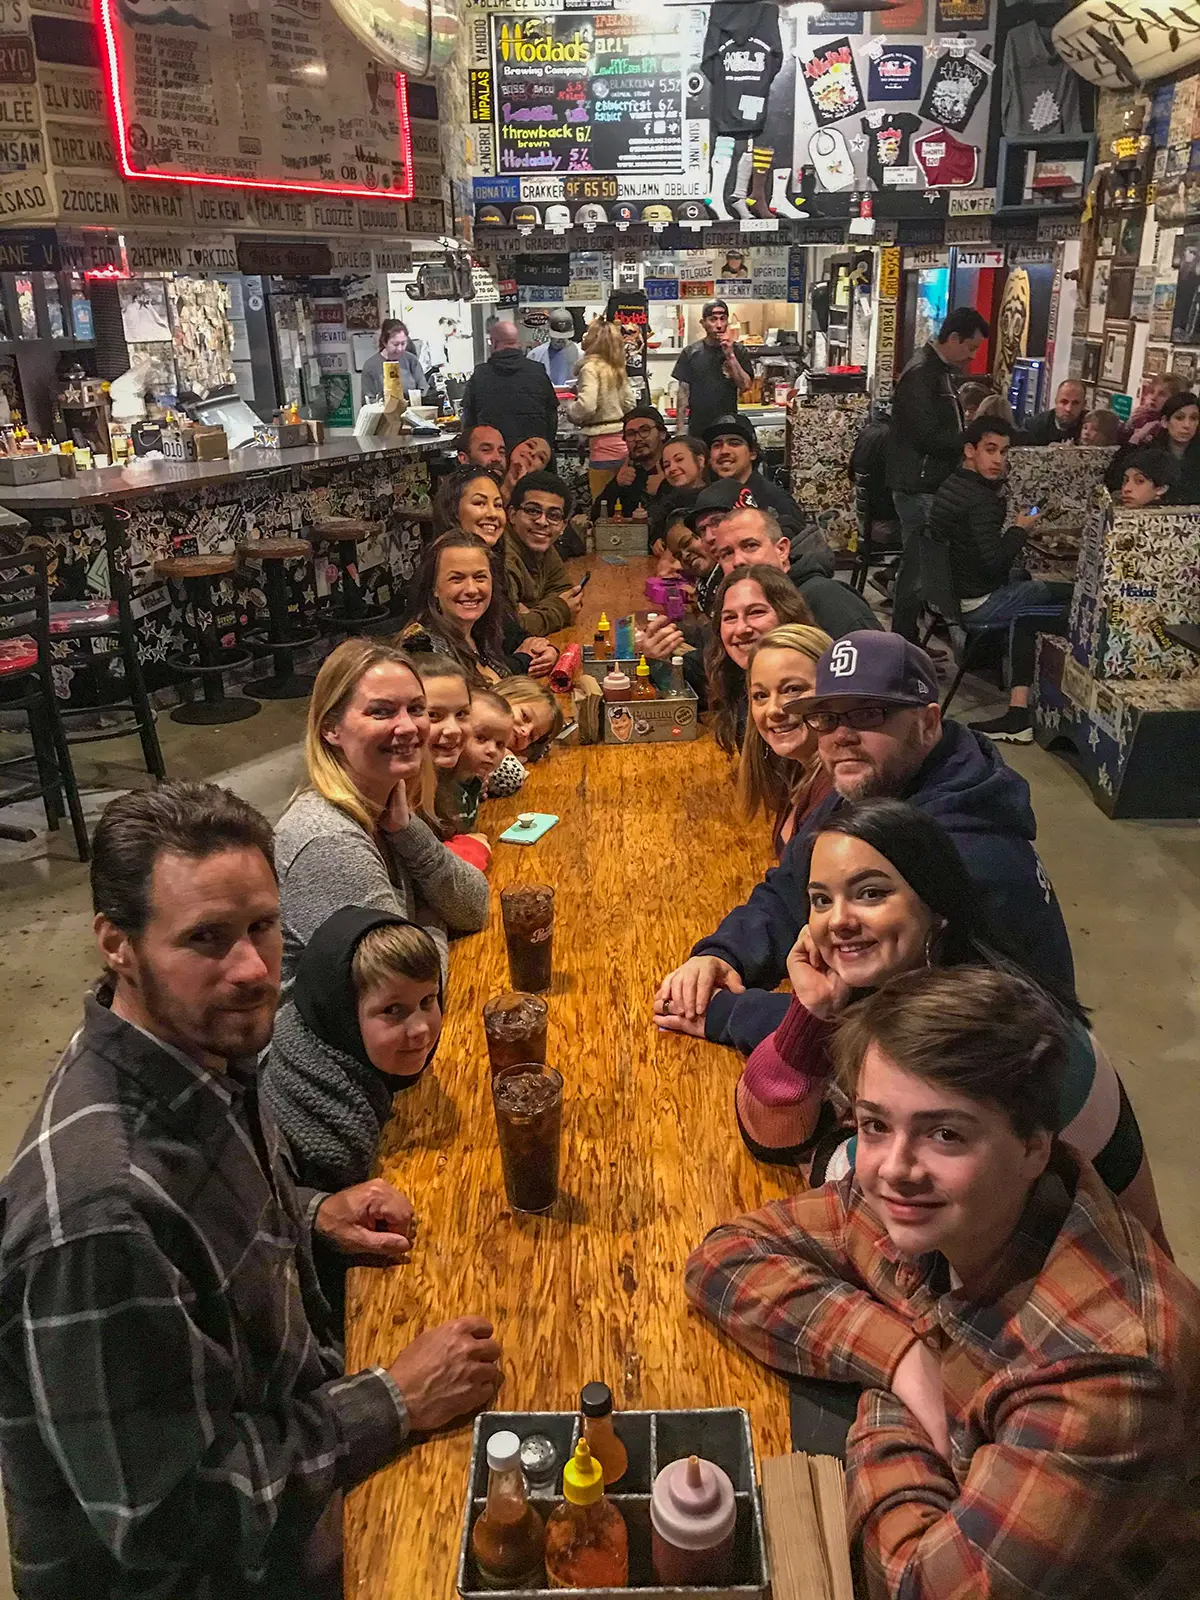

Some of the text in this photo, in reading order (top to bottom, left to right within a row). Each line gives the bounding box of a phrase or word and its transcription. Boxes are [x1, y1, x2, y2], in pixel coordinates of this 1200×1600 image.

[503, 65, 588, 77] Brewing Company
[478, 71, 491, 121] IMPALAS
[502, 123, 592, 143] throwback 6%
[517, 140, 550, 148] brown
[501, 148, 562, 171] Hodaddy
[522, 184, 565, 199] CRAKKER
[584, 181, 599, 197] 65
[602, 181, 616, 196] 50
[131, 247, 183, 267] 2HIPMAN
[958, 251, 986, 264] ATM
[524, 264, 562, 275] Pay Here
[728, 284, 750, 296] HENRY
[829, 640, 858, 677] SD
